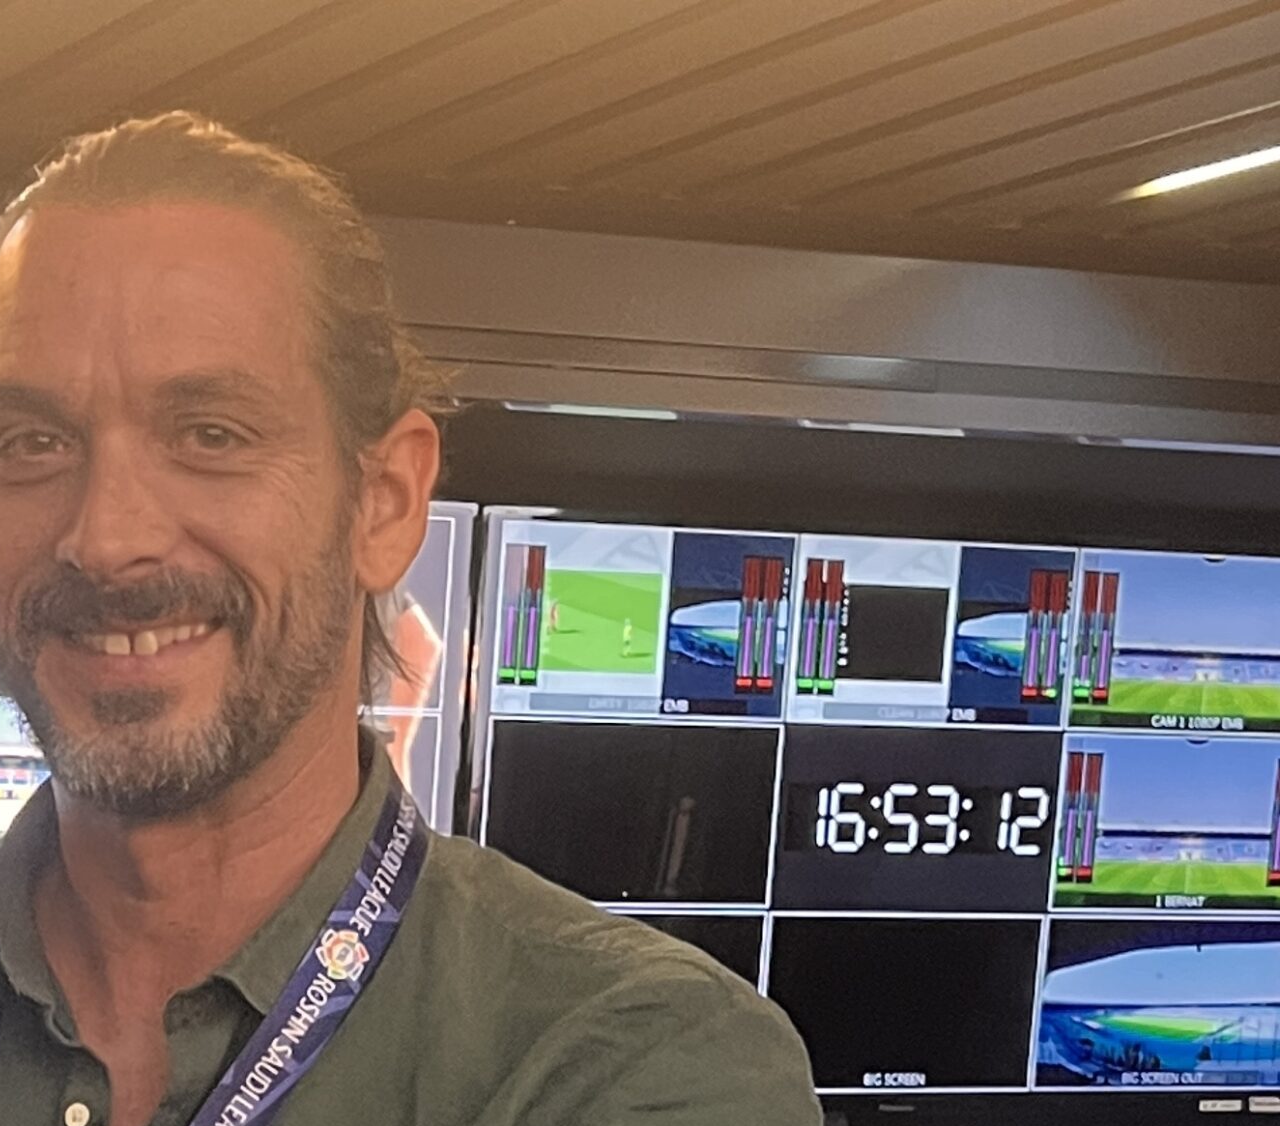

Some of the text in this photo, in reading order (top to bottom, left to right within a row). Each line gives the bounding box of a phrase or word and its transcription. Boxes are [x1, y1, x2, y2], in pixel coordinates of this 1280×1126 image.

[1150, 714, 1177, 728] CAM
[349, 872, 395, 937] LEAGUE
[281, 972, 337, 1044] ROSHN
[240, 1037, 293, 1102] SAUDI
[862, 1072, 926, 1087] BIG SCREEN
